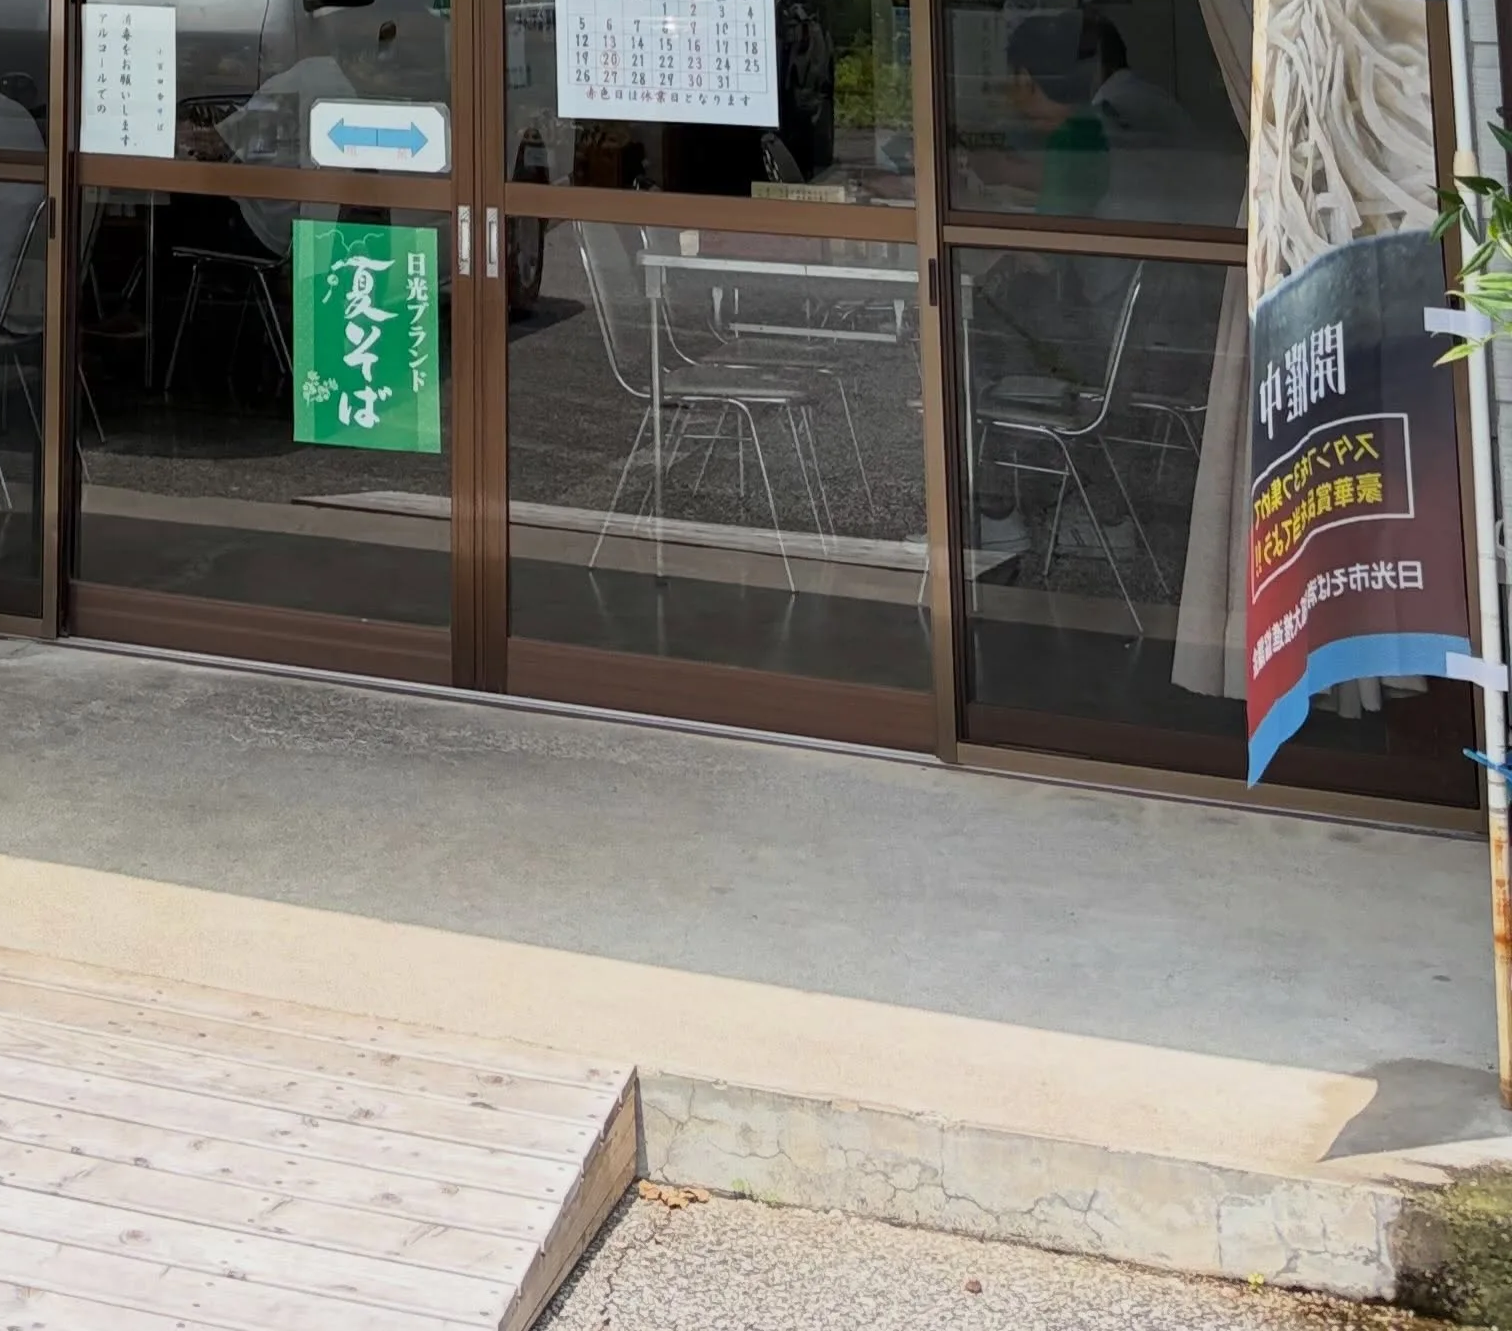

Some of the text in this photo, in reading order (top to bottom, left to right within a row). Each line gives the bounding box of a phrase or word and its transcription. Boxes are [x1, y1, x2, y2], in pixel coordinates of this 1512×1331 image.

[690, 3, 697, 16] 2
[718, 5, 725, 18] 3
[747, 6, 754, 19] 4
[579, 17, 586, 30] 5
[606, 18, 613, 31] 6
[633, 20, 641, 33] 7
[690, 21, 697, 34] 9
[715, 23, 728, 35] 10
[744, 23, 756, 36] 11
[576, 34, 758, 55] 12 13 14 15 16 17 18
[96, 12, 108, 114] アルコールでの
[576, 51, 760, 73] 19 20 21 22 23 24 25
[576, 69, 729, 89] 26 27 28 29 30 31
[406, 252, 429, 393] 日光ブランド
[338, 255, 399, 429] 夏そば
